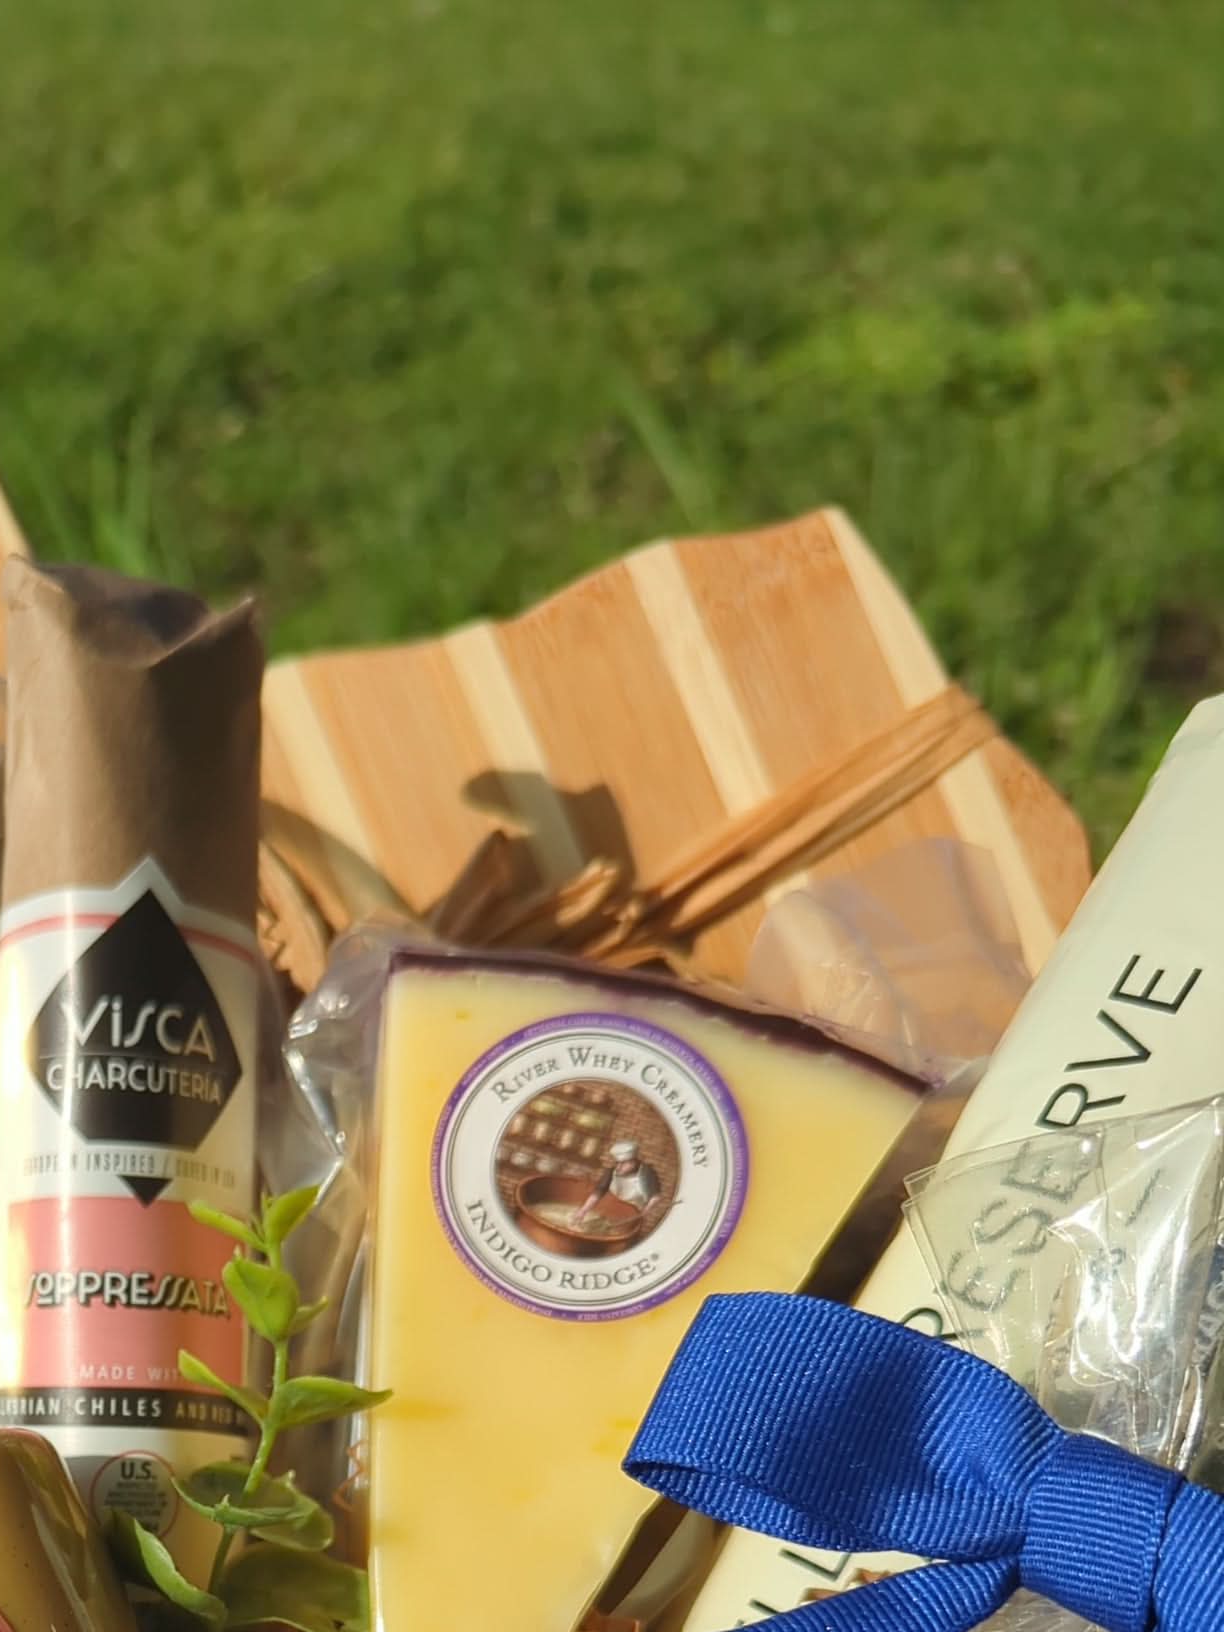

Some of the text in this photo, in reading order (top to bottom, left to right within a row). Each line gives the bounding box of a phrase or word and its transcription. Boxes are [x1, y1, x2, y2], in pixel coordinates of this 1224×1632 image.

[86, 1152, 155, 1174] INSPIRED
[465, 1200, 553, 1283] INDIGO
[79, 1365, 179, 1381] MADE WIT
[75, 1399, 162, 1417] CHILES
